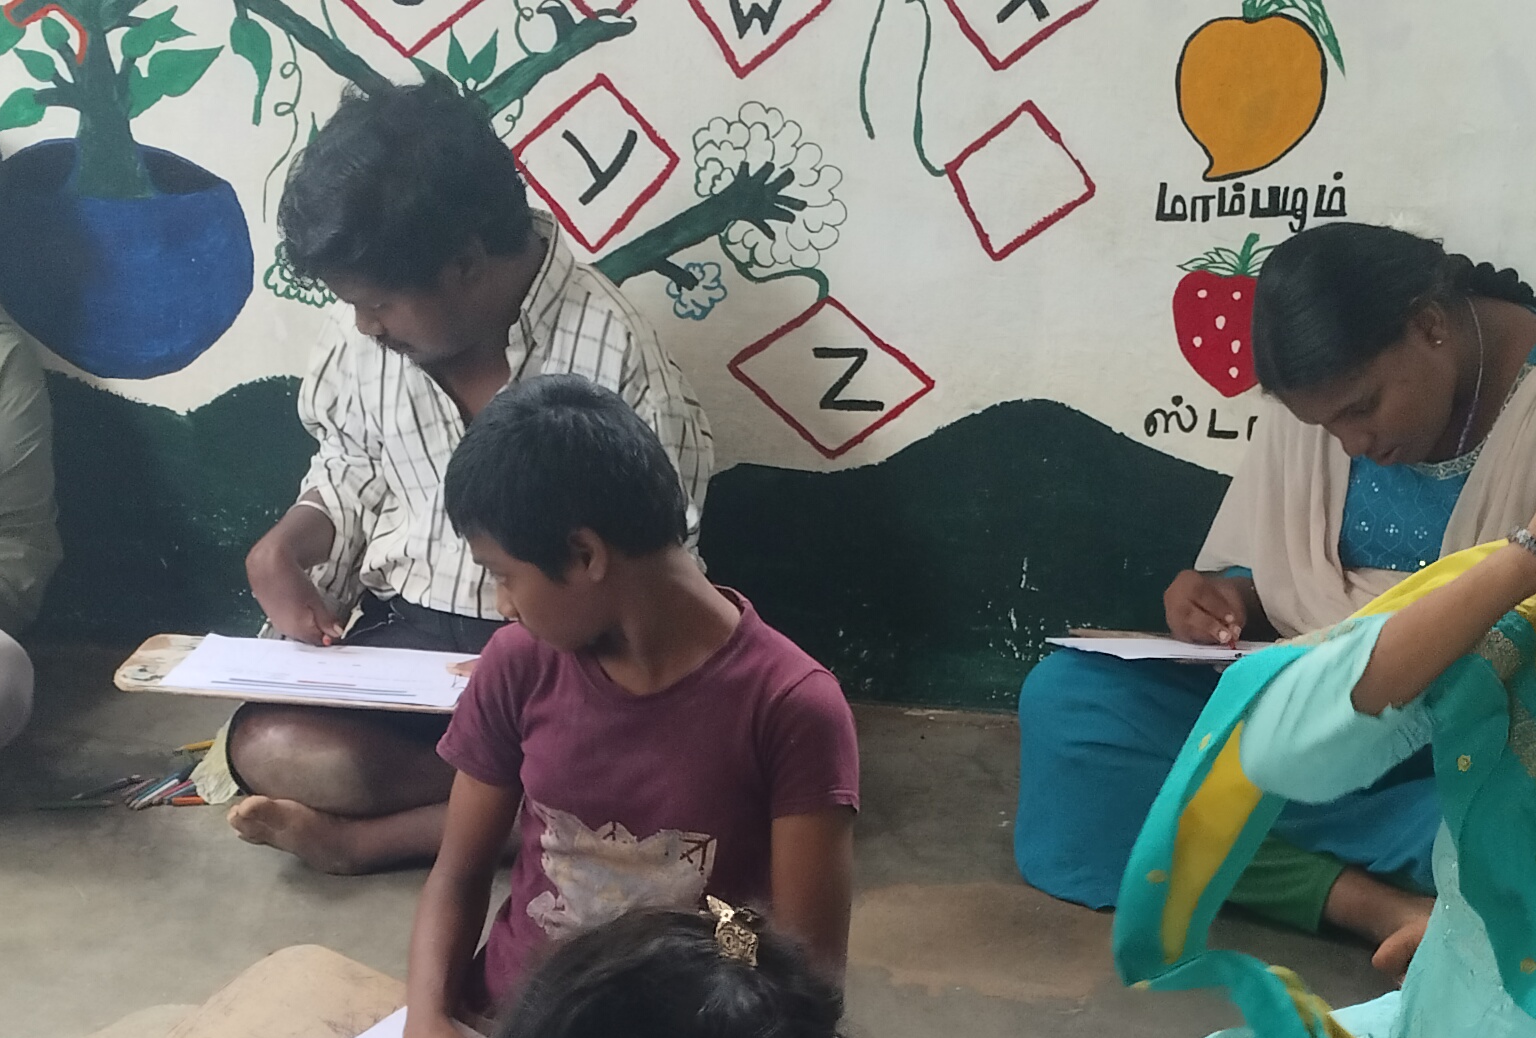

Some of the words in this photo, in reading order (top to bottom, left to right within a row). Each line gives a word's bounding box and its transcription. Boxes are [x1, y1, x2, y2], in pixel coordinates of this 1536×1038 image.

[562, 129, 637, 207] Y
[1155, 171, 1348, 233] மாம்பழம்
[812, 346, 885, 413] Z
